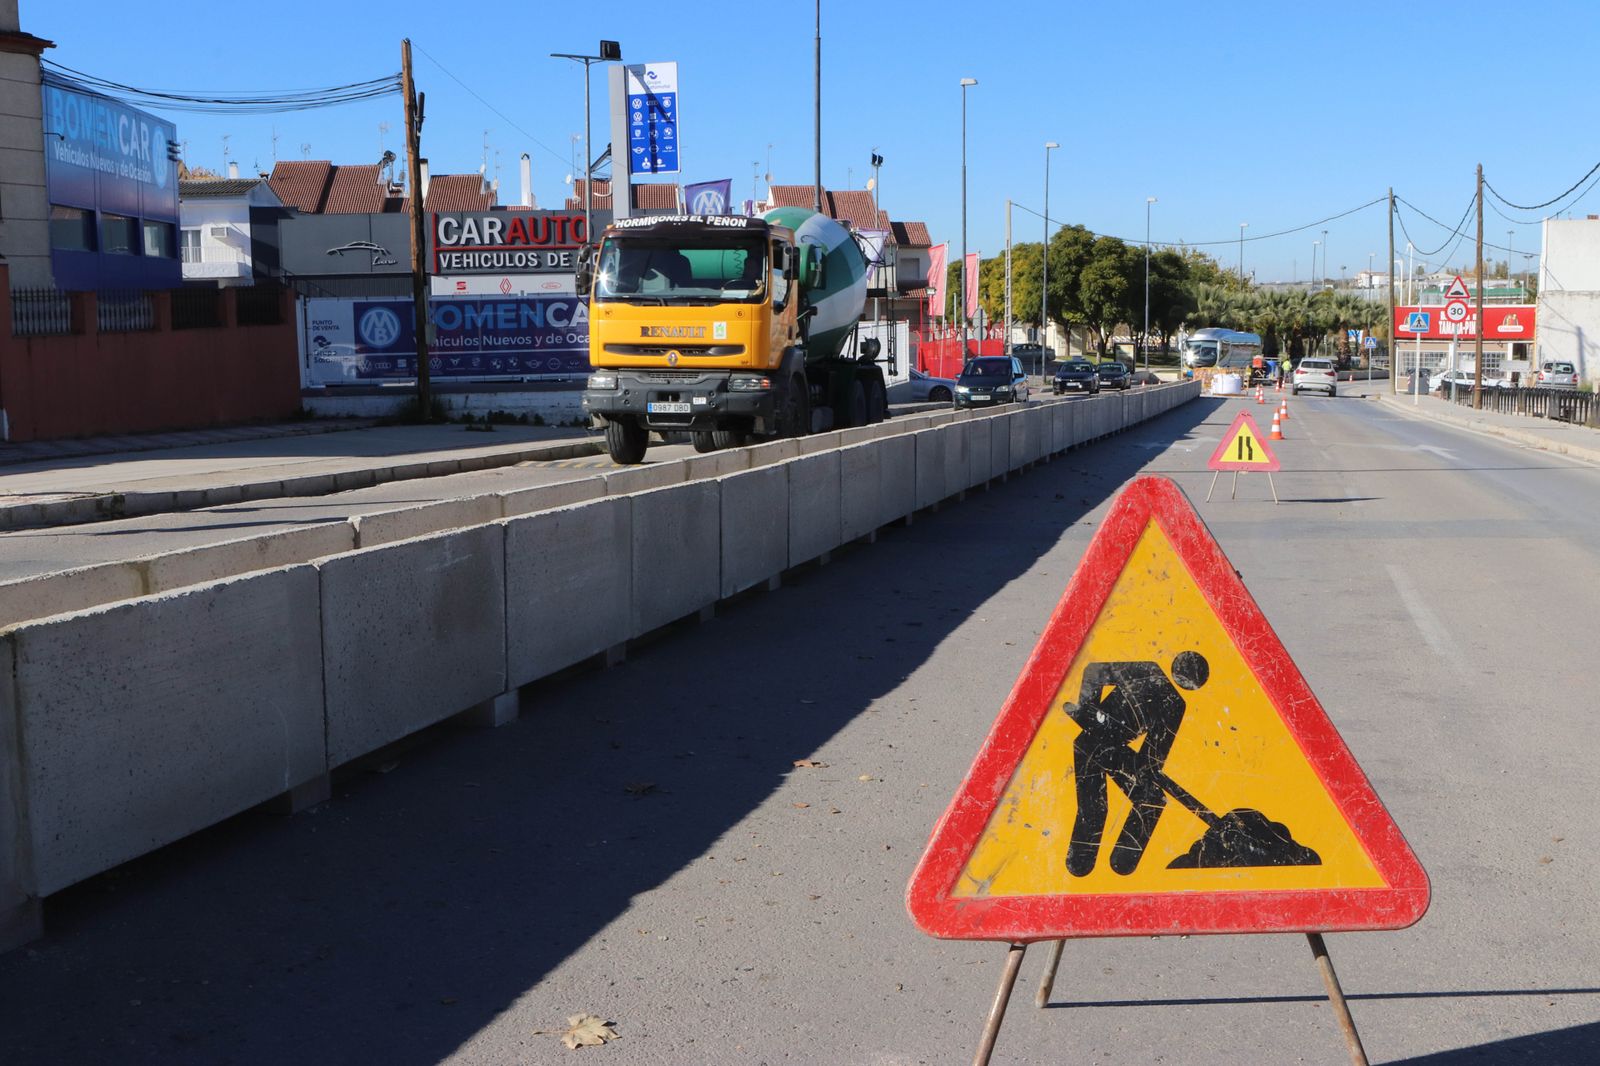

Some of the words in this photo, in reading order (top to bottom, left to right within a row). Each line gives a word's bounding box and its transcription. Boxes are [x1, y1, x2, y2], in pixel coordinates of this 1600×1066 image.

[51, 88, 150, 162] BOMENCAR
[89, 151, 115, 174] Nuevos
[120, 160, 129, 177] de
[616, 215, 688, 229] HORMIGONES
[438, 215, 588, 246] CARAUTO
[439, 252, 538, 268] VEHICULOS
[547, 253, 569, 267] DE
[1450, 307, 1463, 316] 30
[482, 334, 531, 346] Nuevos
[535, 335, 542, 347] y
[545, 332, 562, 345] de
[640, 326, 707, 338] RENAULT
[653, 404, 671, 412] 0987
